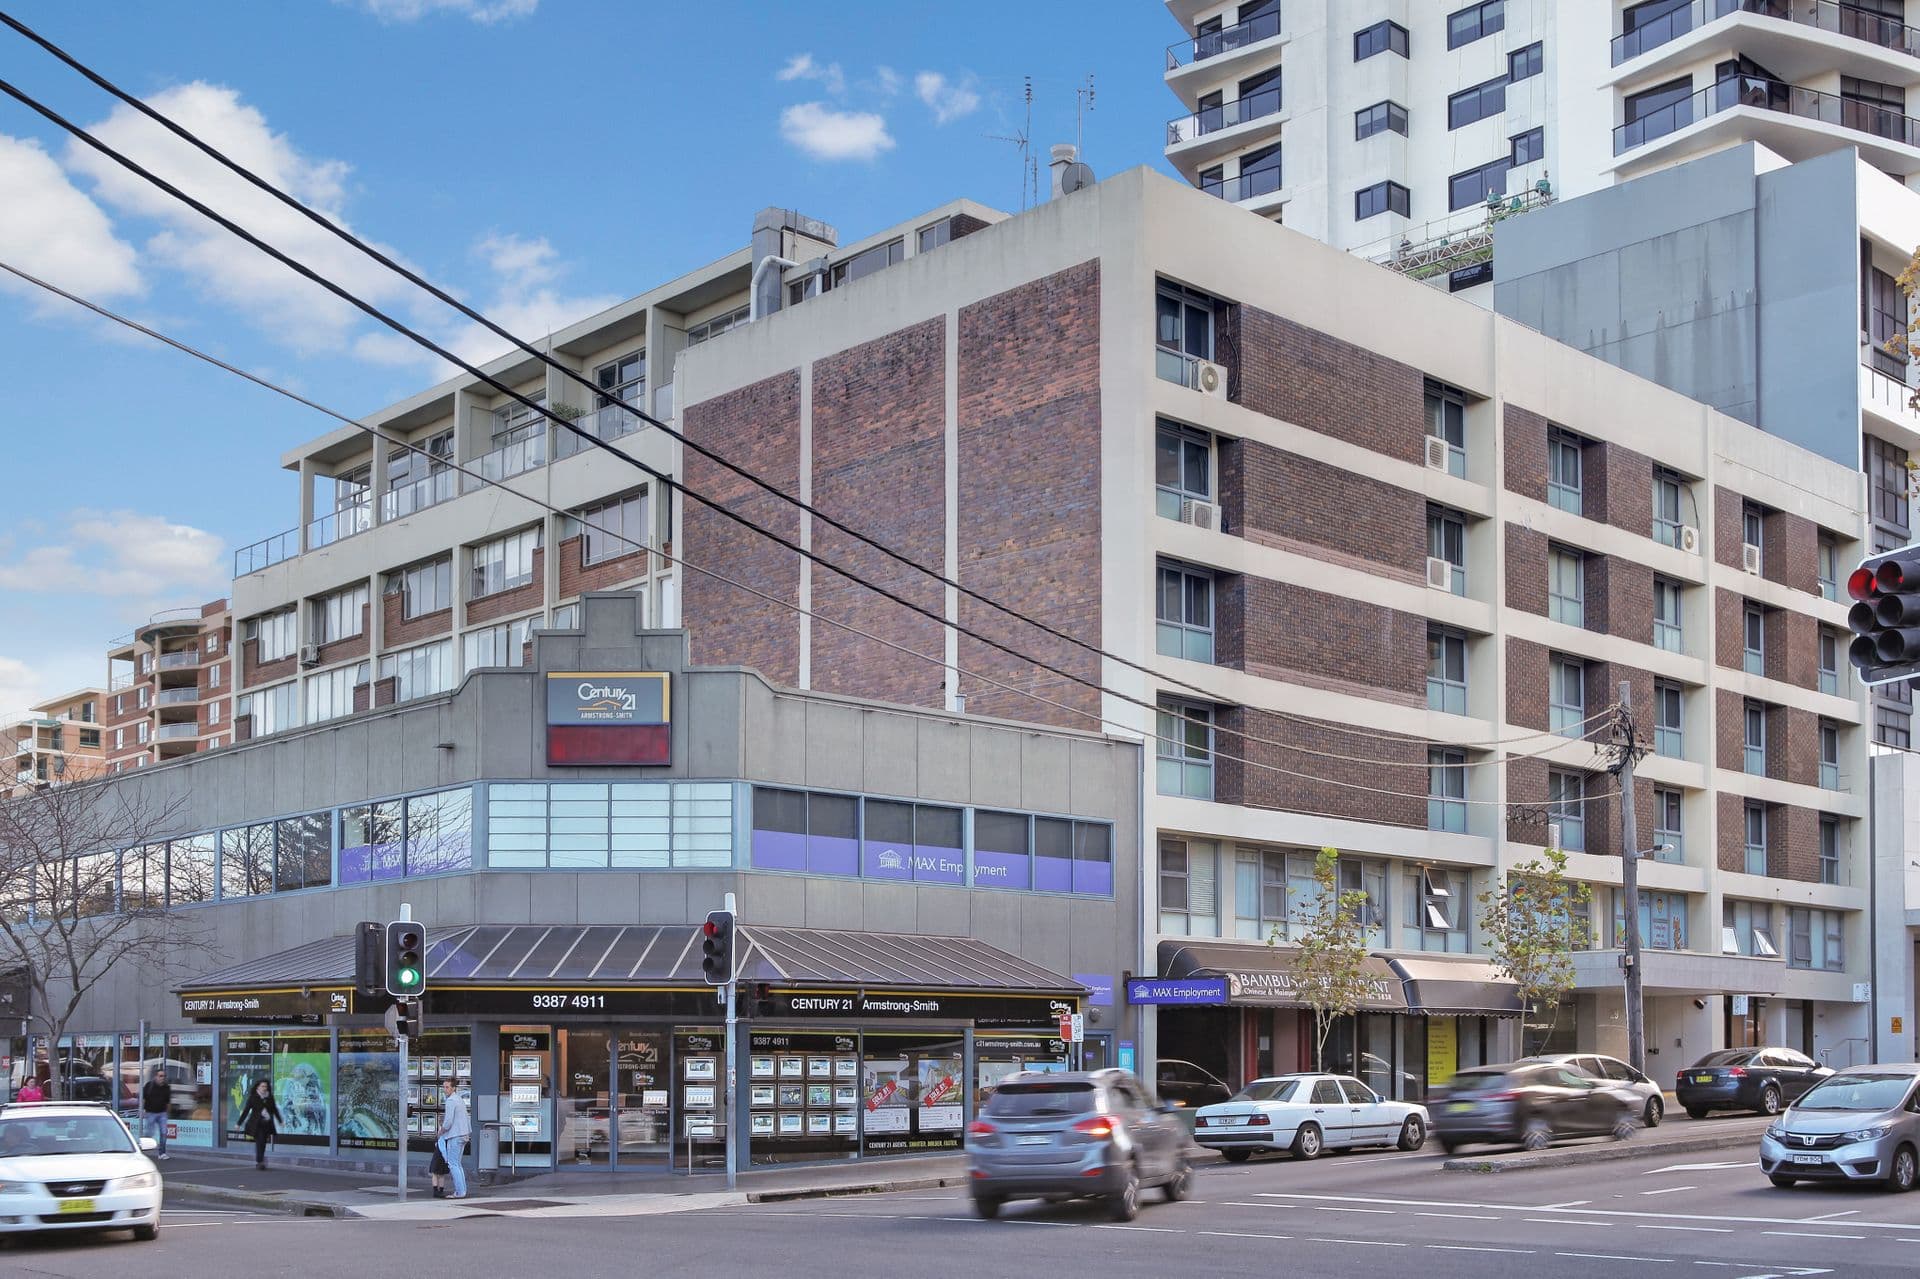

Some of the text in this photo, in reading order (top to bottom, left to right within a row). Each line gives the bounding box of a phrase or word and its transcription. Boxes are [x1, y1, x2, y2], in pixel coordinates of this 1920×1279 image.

[578, 683, 636, 710] Century 21
[908, 857, 1007, 876] MAX Empyment
[1153, 987, 1220, 999] MAX Employment
[184, 998, 260, 1011] CENTURY 21 Armstrong-Smith
[533, 995, 605, 1008] 9387 4911
[791, 998, 939, 1013] CENTURY 21 Armstrong-Smith
[753, 1037, 789, 1046] 9387 4911
[645, 1048, 658, 1062] 21
